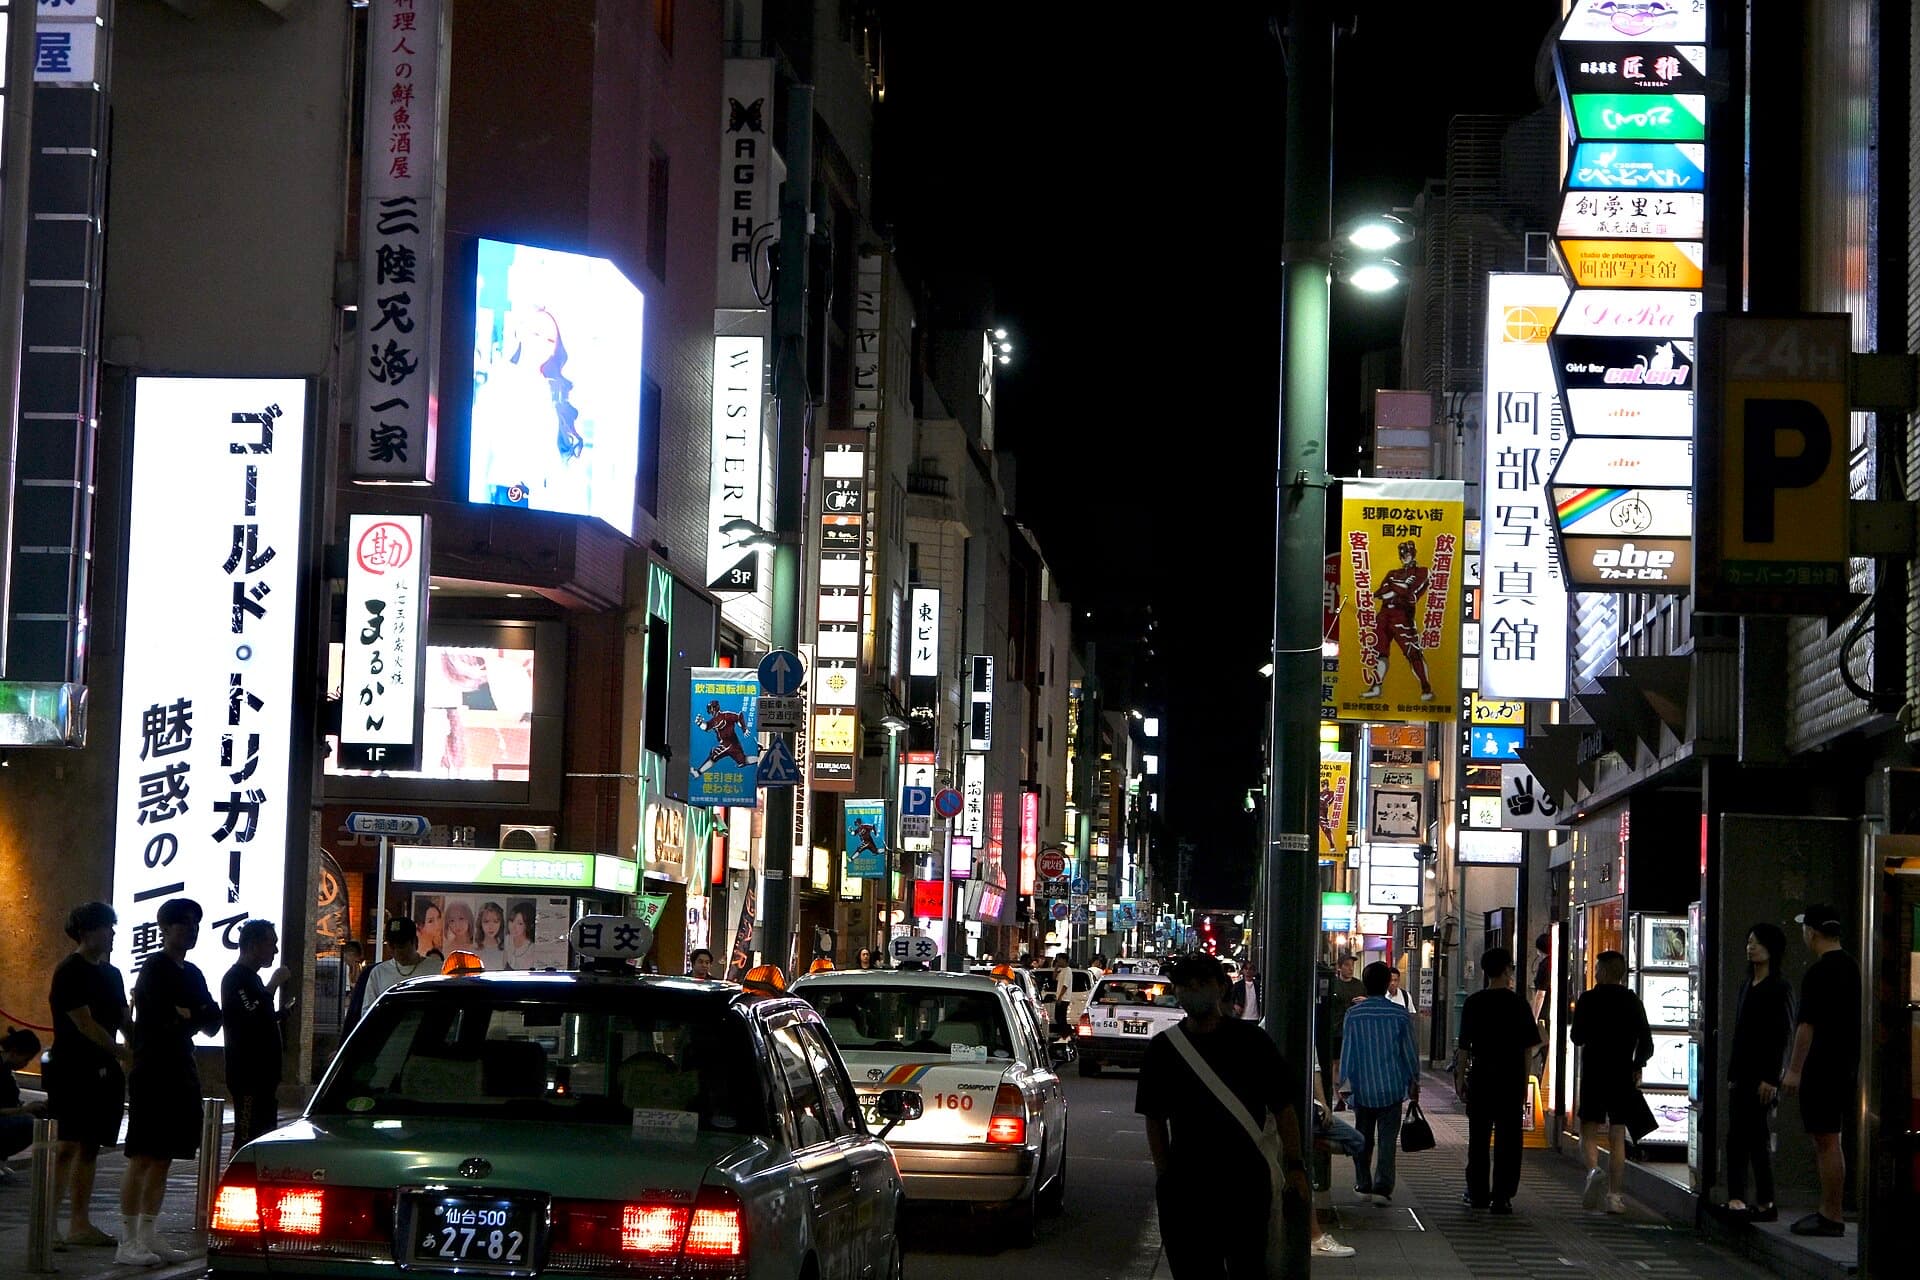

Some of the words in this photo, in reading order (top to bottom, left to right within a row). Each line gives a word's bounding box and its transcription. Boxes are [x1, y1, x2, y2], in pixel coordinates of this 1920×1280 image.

[35, 0, 71, 72] 屋
[390, 0, 416, 178] 理人の鮮魚酒屋
[731, 138, 755, 263] AGEHA
[1580, 260, 1677, 279] 阿部写真館
[1530, 326, 1553, 337] AB
[1565, 362, 1587, 373] Girls
[1743, 398, 1832, 543] P
[1362, 506, 1444, 521] 犯罪のない街
[1382, 524, 1423, 538] 国分町
[1490, 391, 1542, 661] 阿部写真館
[1592, 543, 1675, 568] abe
[730, 568, 751, 584] 3F
[1420, 534, 1456, 650] 飲酒運転根絶
[1348, 531, 1382, 686] 客引きは使わない
[1464, 592, 1473, 617] 8F
[917, 603, 933, 661] 東ビル
[360, 599, 387, 731] まるかん
[1463, 696, 1471, 720] 3F
[366, 747, 386, 761] 1F
[1462, 731, 1470, 754] 1F
[909, 789, 927, 813] P
[1461, 800, 1469, 824] 1F
[577, 923, 641, 951] 日交
[894, 940, 932, 958] 日交
[957, 1082, 996, 1091] COMFORT
[934, 1092, 974, 1111] 160
[446, 1208, 507, 1226] 仙台500
[422, 1233, 437, 1248] あ
[439, 1226, 524, 1261] 27-82
